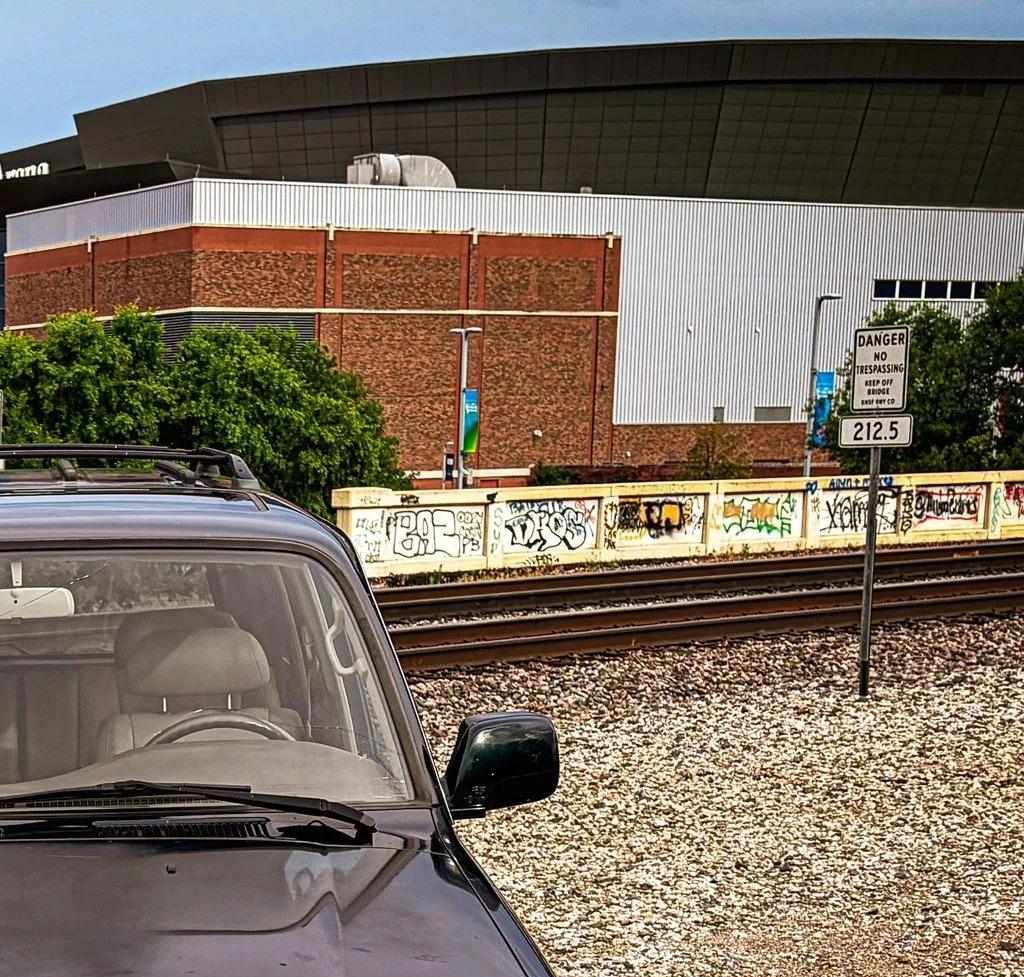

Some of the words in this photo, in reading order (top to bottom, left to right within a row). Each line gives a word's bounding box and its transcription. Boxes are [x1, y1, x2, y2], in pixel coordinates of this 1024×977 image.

[858, 333, 905, 347] DANGER
[873, 351, 887, 361] NO
[856, 363, 904, 375] TRESPASSING
[864, 379, 880, 387] KEEP
[867, 387, 890, 396] BRIDGE
[853, 421, 898, 441] 212.5
